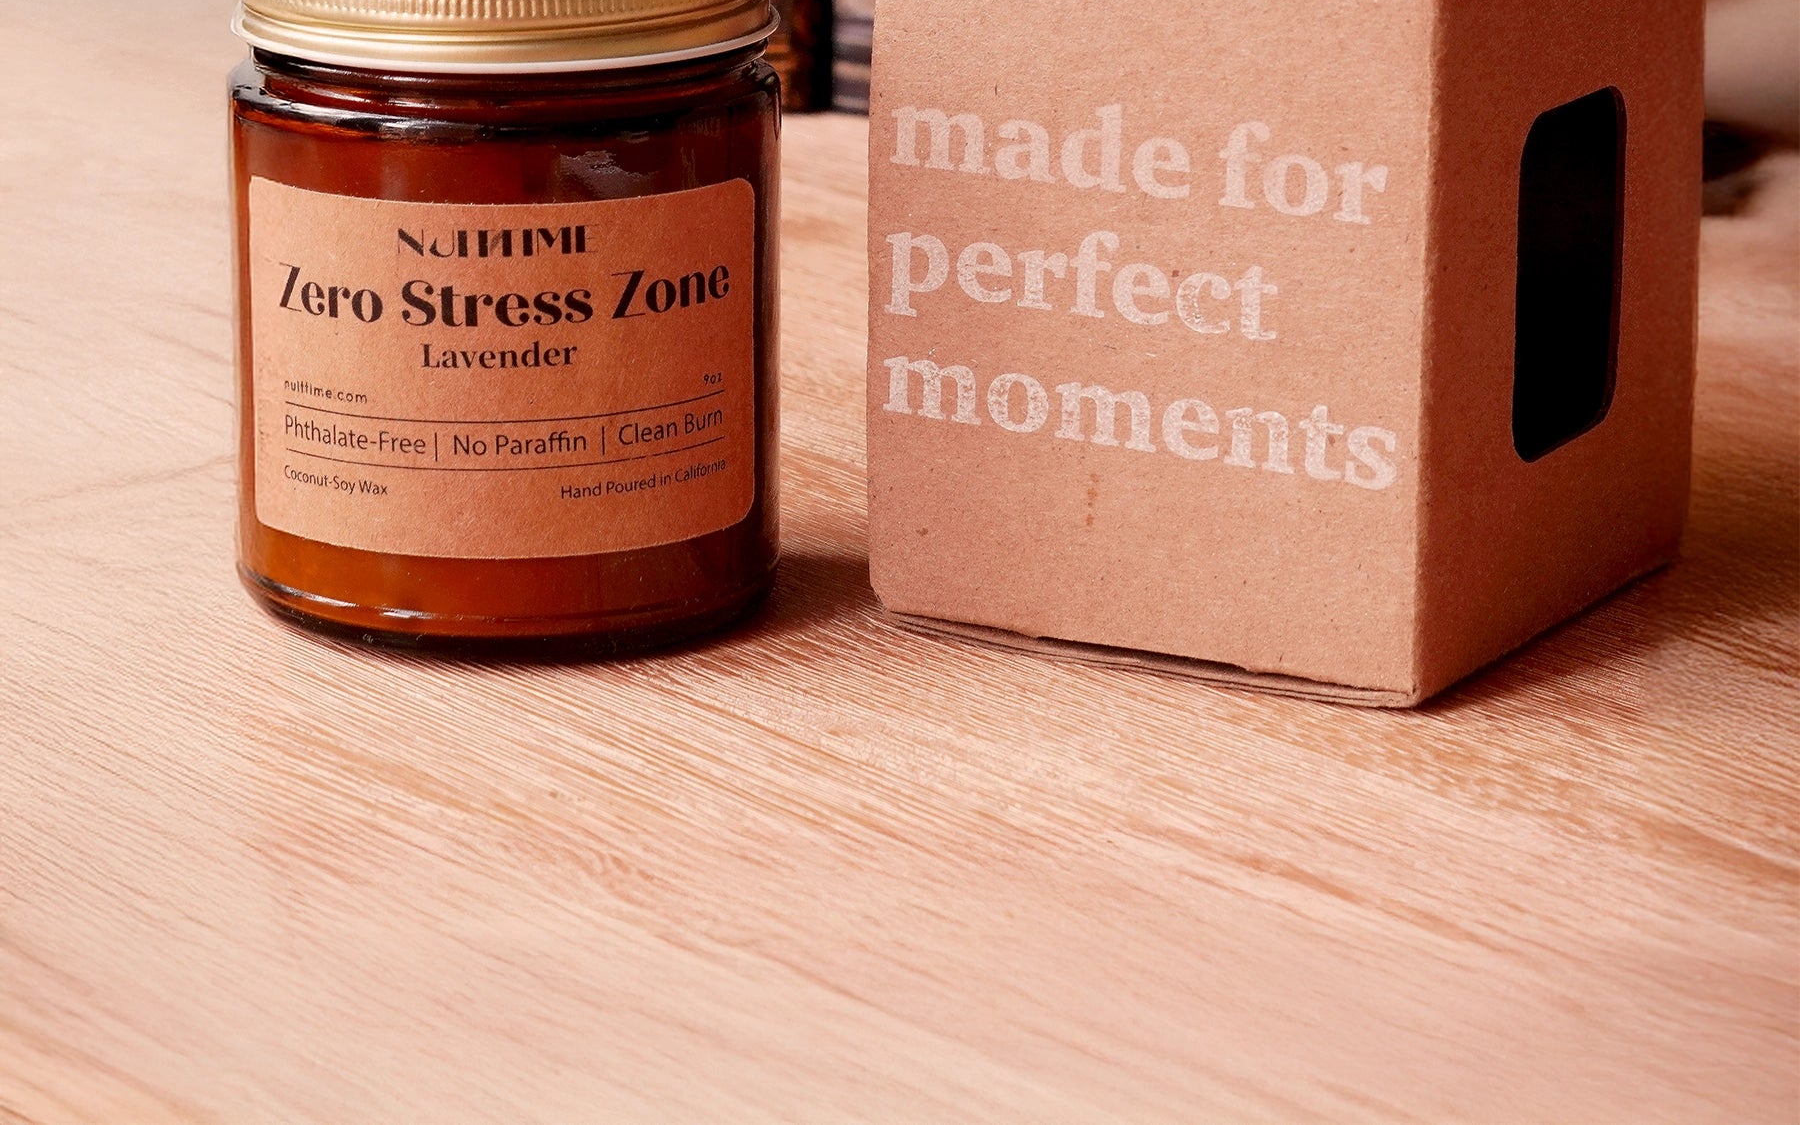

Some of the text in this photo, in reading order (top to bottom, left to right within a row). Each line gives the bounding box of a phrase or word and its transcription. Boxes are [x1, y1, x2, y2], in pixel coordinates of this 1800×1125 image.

[889, 103, 1389, 224] made for
[278, 262, 730, 328] Zero Stress Zone
[884, 230, 1278, 341] perfect
[421, 340, 579, 369] Lavender
[284, 409, 723, 457] Phthalate-Free No Paraffin Clean Burn
[881, 355, 1399, 491] moments
[284, 464, 388, 495] Coconut-Soy Wax
[561, 458, 726, 499] Hand Poured in California
